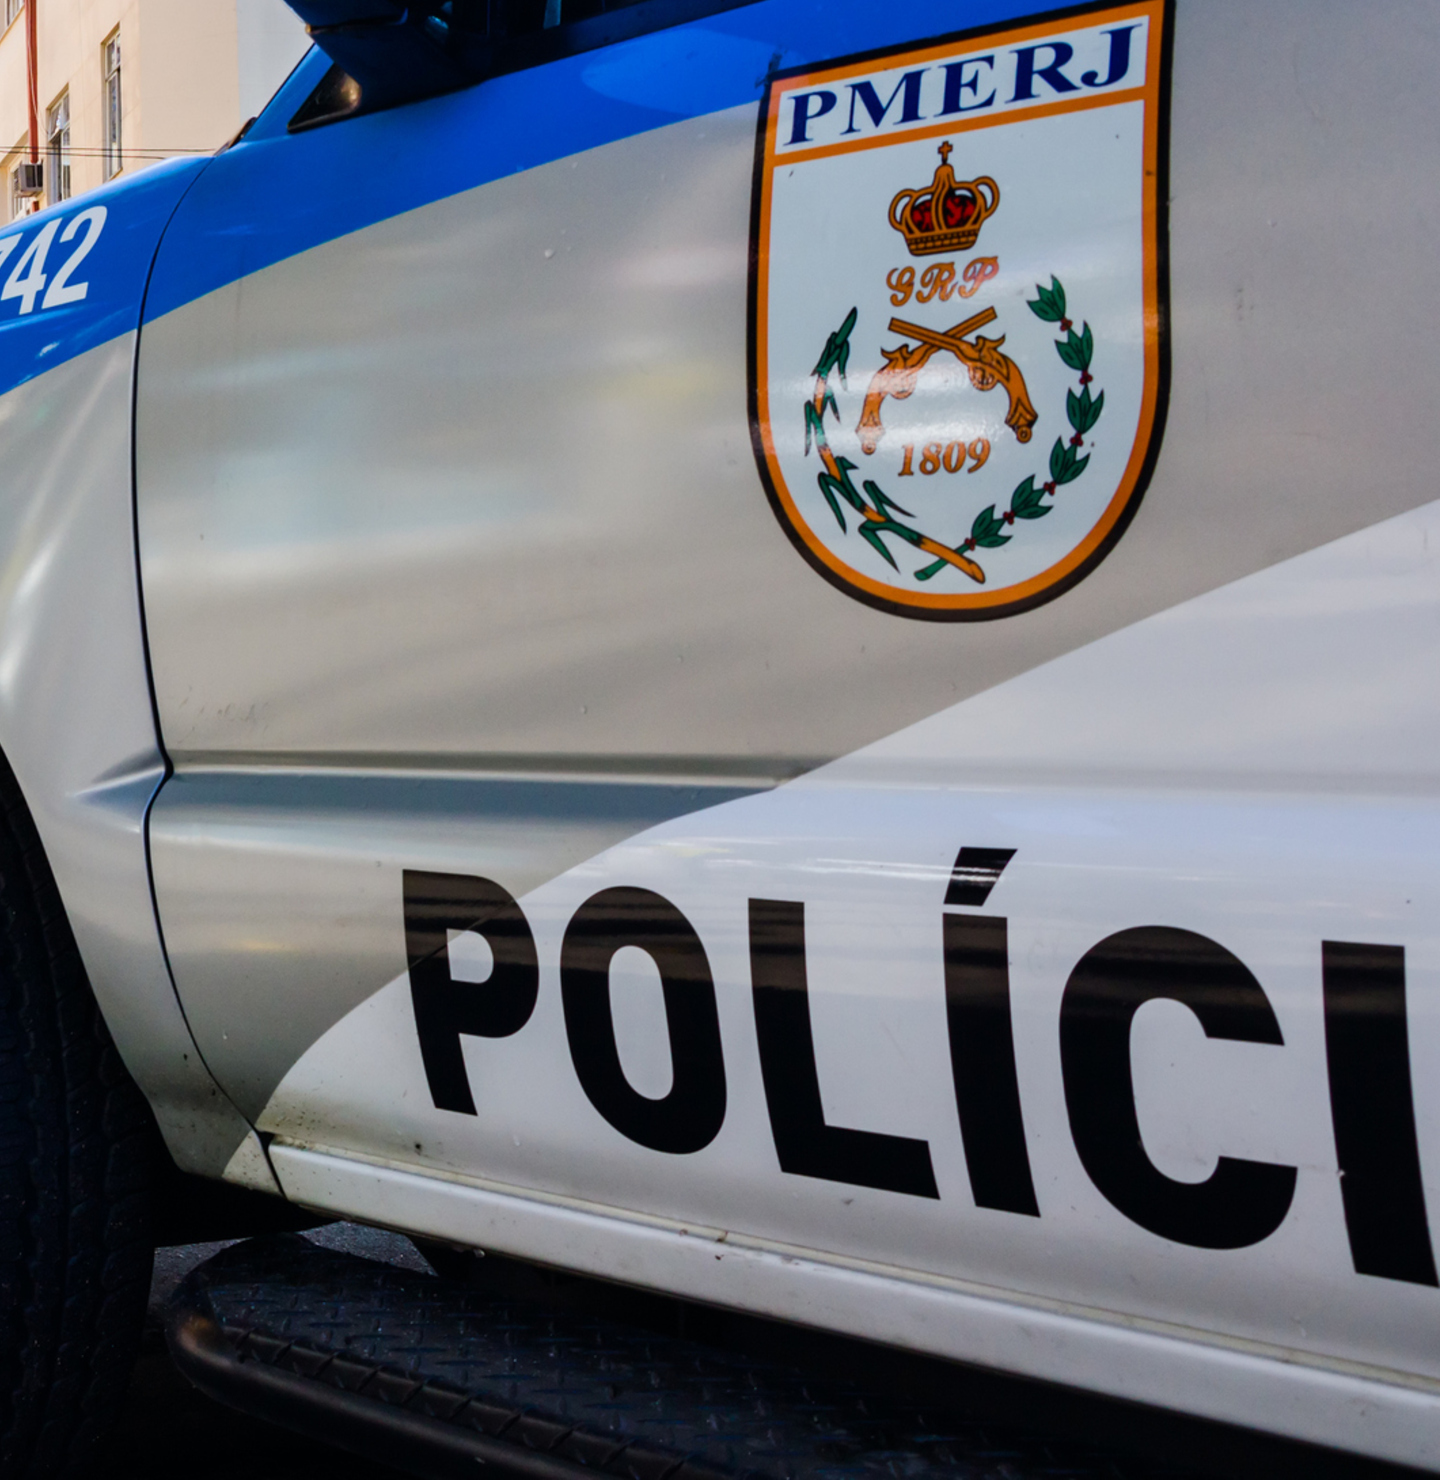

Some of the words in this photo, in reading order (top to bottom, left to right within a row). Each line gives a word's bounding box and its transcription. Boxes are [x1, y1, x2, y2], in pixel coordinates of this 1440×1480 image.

[783, 23, 1143, 148] PMERJ
[886, 256, 999, 307] GRP
[897, 437, 991, 477] 1809
[402, 846, 1440, 1288] POLÍCI
